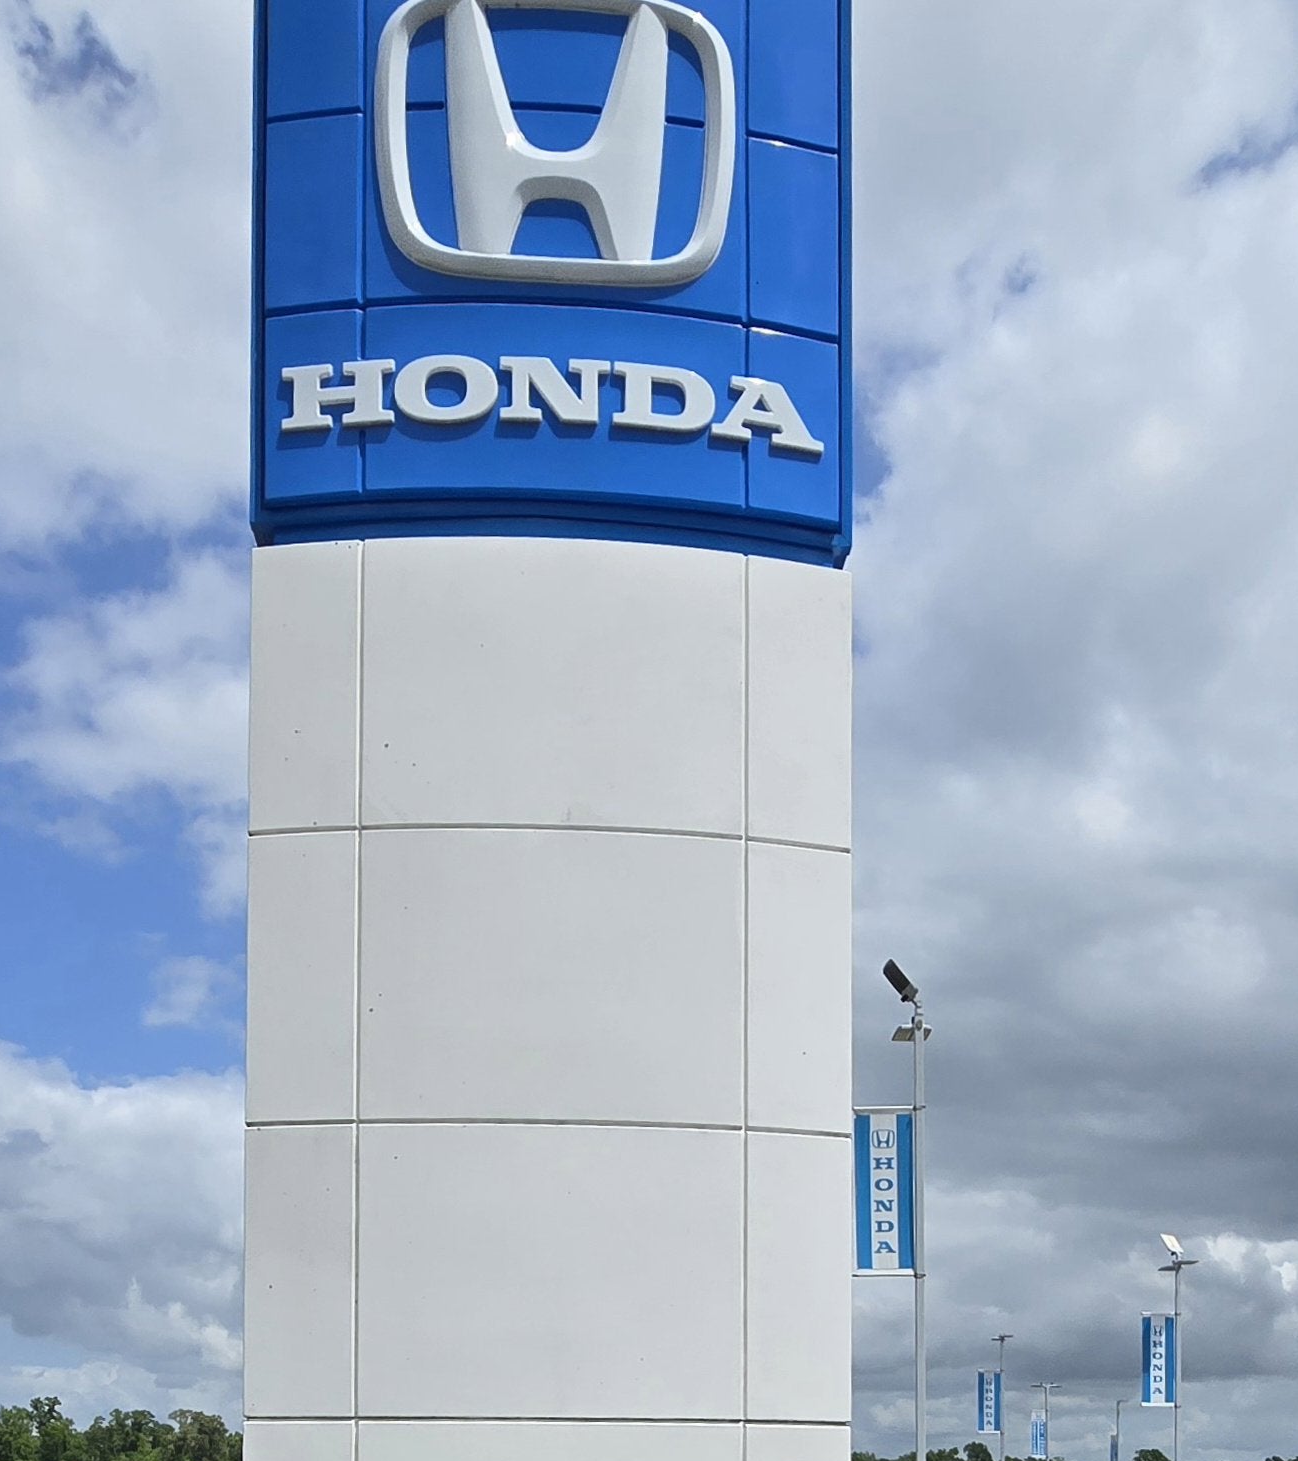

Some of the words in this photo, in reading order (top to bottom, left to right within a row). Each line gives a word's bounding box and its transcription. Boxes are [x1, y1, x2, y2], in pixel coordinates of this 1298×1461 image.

[280, 353, 825, 459] HONDA
[872, 1156, 897, 1254] HONDA
[1152, 1340, 1164, 1395] HONDA
[985, 1388, 994, 1426] HONDA
